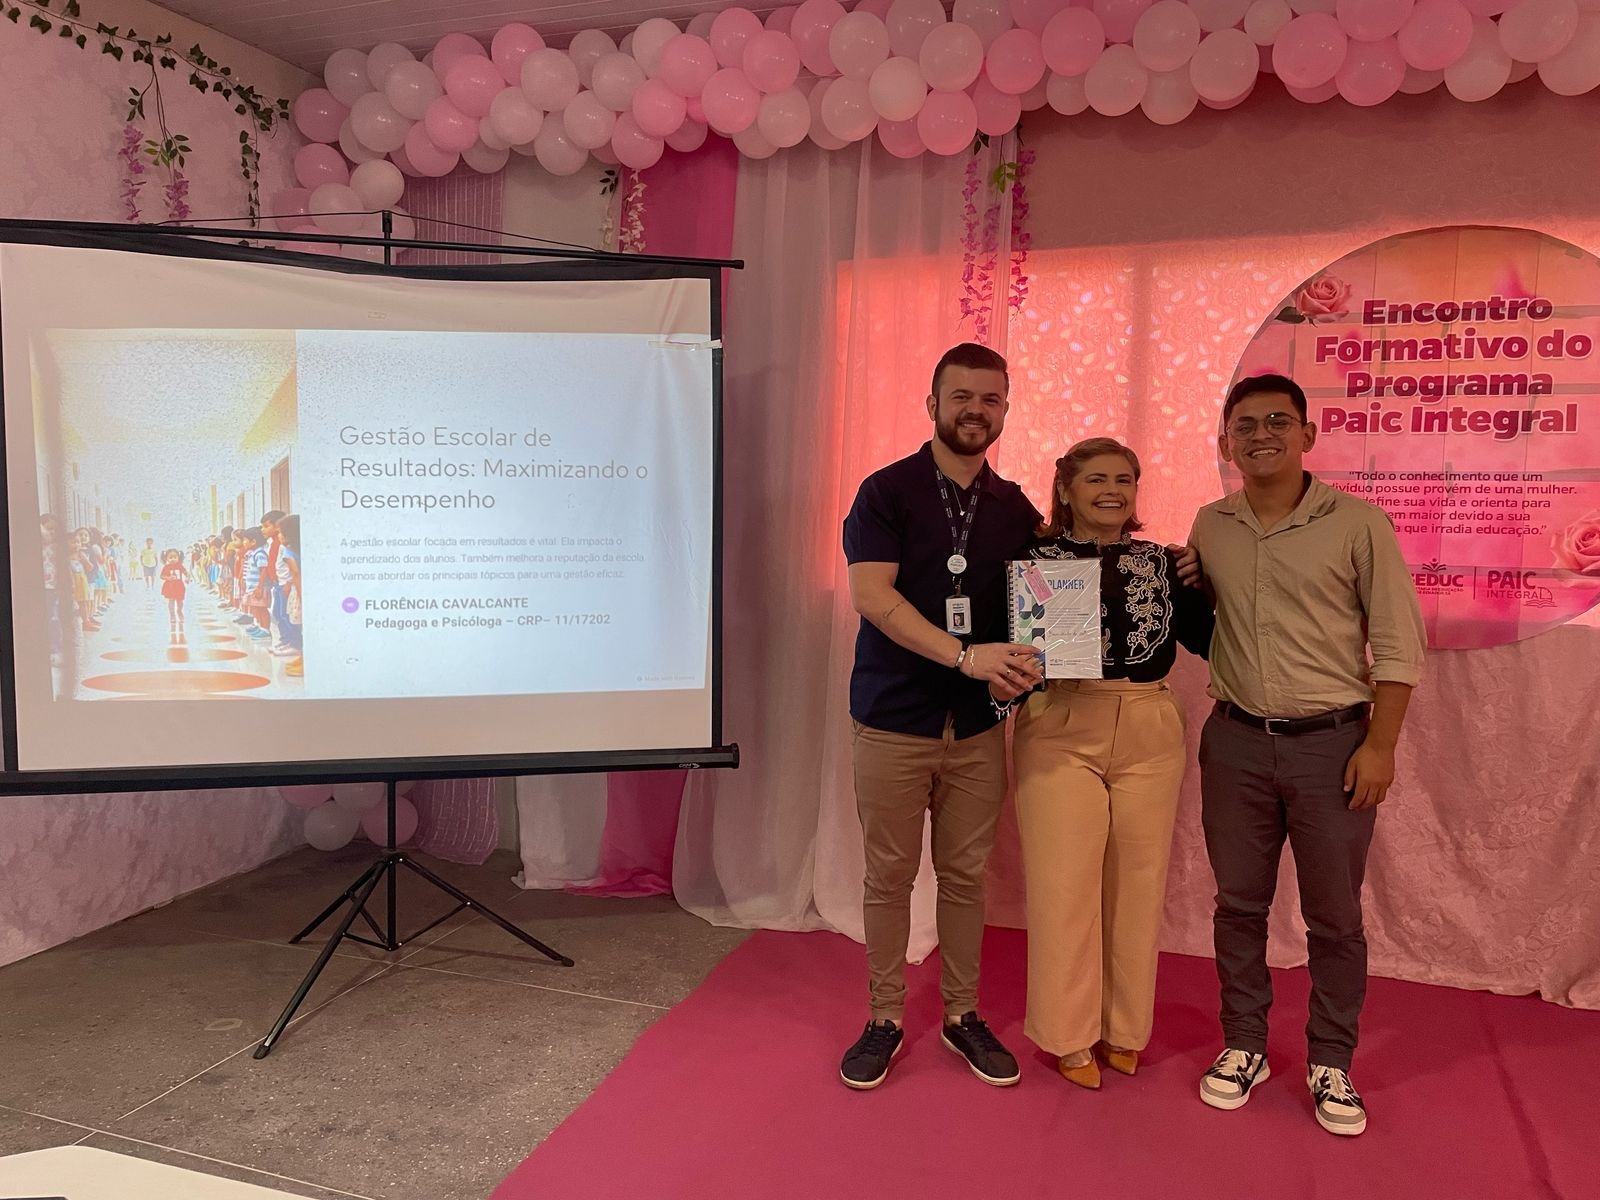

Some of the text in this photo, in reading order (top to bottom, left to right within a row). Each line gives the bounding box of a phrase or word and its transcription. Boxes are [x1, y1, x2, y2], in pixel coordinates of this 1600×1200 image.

[1363, 296, 1552, 325] Encontro
[1316, 328, 1592, 363] Formativo do
[1347, 372, 1553, 402] Programa
[1322, 403, 1577, 440] Paic Integral
[340, 426, 551, 446] Gestão Escolar de
[341, 457, 648, 479] Resultados: Maximizando o
[1389, 473, 1396, 481] o
[1399, 471, 1491, 481] conhecimento
[1494, 473, 1518, 482] que
[1523, 473, 1543, 482] um
[1375, 485, 1420, 494] possue
[1423, 483, 1471, 494] provém
[1475, 484, 1491, 494] de
[1495, 486, 1523, 494] uma
[1527, 484, 1577, 495] mulher.
[341, 489, 495, 513] Desempenho
[1403, 498, 1426, 507] sua
[1429, 497, 1456, 507] vida
[1460, 499, 1467, 507] e
[1471, 498, 1518, 508] orienta
[1521, 500, 1551, 509] para
[1409, 510, 1446, 520] maior
[1449, 510, 1493, 520] devido
[1496, 513, 1504, 521] a
[1508, 513, 1531, 521] sua
[1404, 525, 1428, 535] que
[1431, 524, 1472, 534] irradia
[340, 537, 348, 547] A
[350, 537, 383, 549] gestão
[386, 537, 421, 547] escolar
[424, 537, 457, 546] focada
[478, 536, 527, 546] resultados
[561, 536, 575, 546] Ela
[577, 536, 614, 548] impacta
[616, 538, 623, 546] o
[341, 554, 401, 565] aprendizado
[403, 554, 421, 564] dos
[461, 553, 504, 563] Também
[506, 553, 544, 563] melhora
[554, 553, 600, 564] reputação
[602, 552, 614, 562] da
[341, 571, 376, 581] Vamos
[378, 570, 415, 581] abordar
[432, 571, 478, 582] principais
[481, 570, 515, 581] tópicos
[517, 571, 538, 581] para
[540, 571, 562, 579] uma
[563, 569, 594, 581] gestão
[1487, 570, 1537, 590] PAIC
[1048, 580, 1084, 590] PLANNER
[365, 596, 529, 610] FLORÊNCIA CAVALCANTE
[365, 616, 428, 630] Pedagoga
[431, 619, 439, 627] e
[442, 615, 502, 629] Psicóloga
[555, 614, 611, 626] 11/17202
